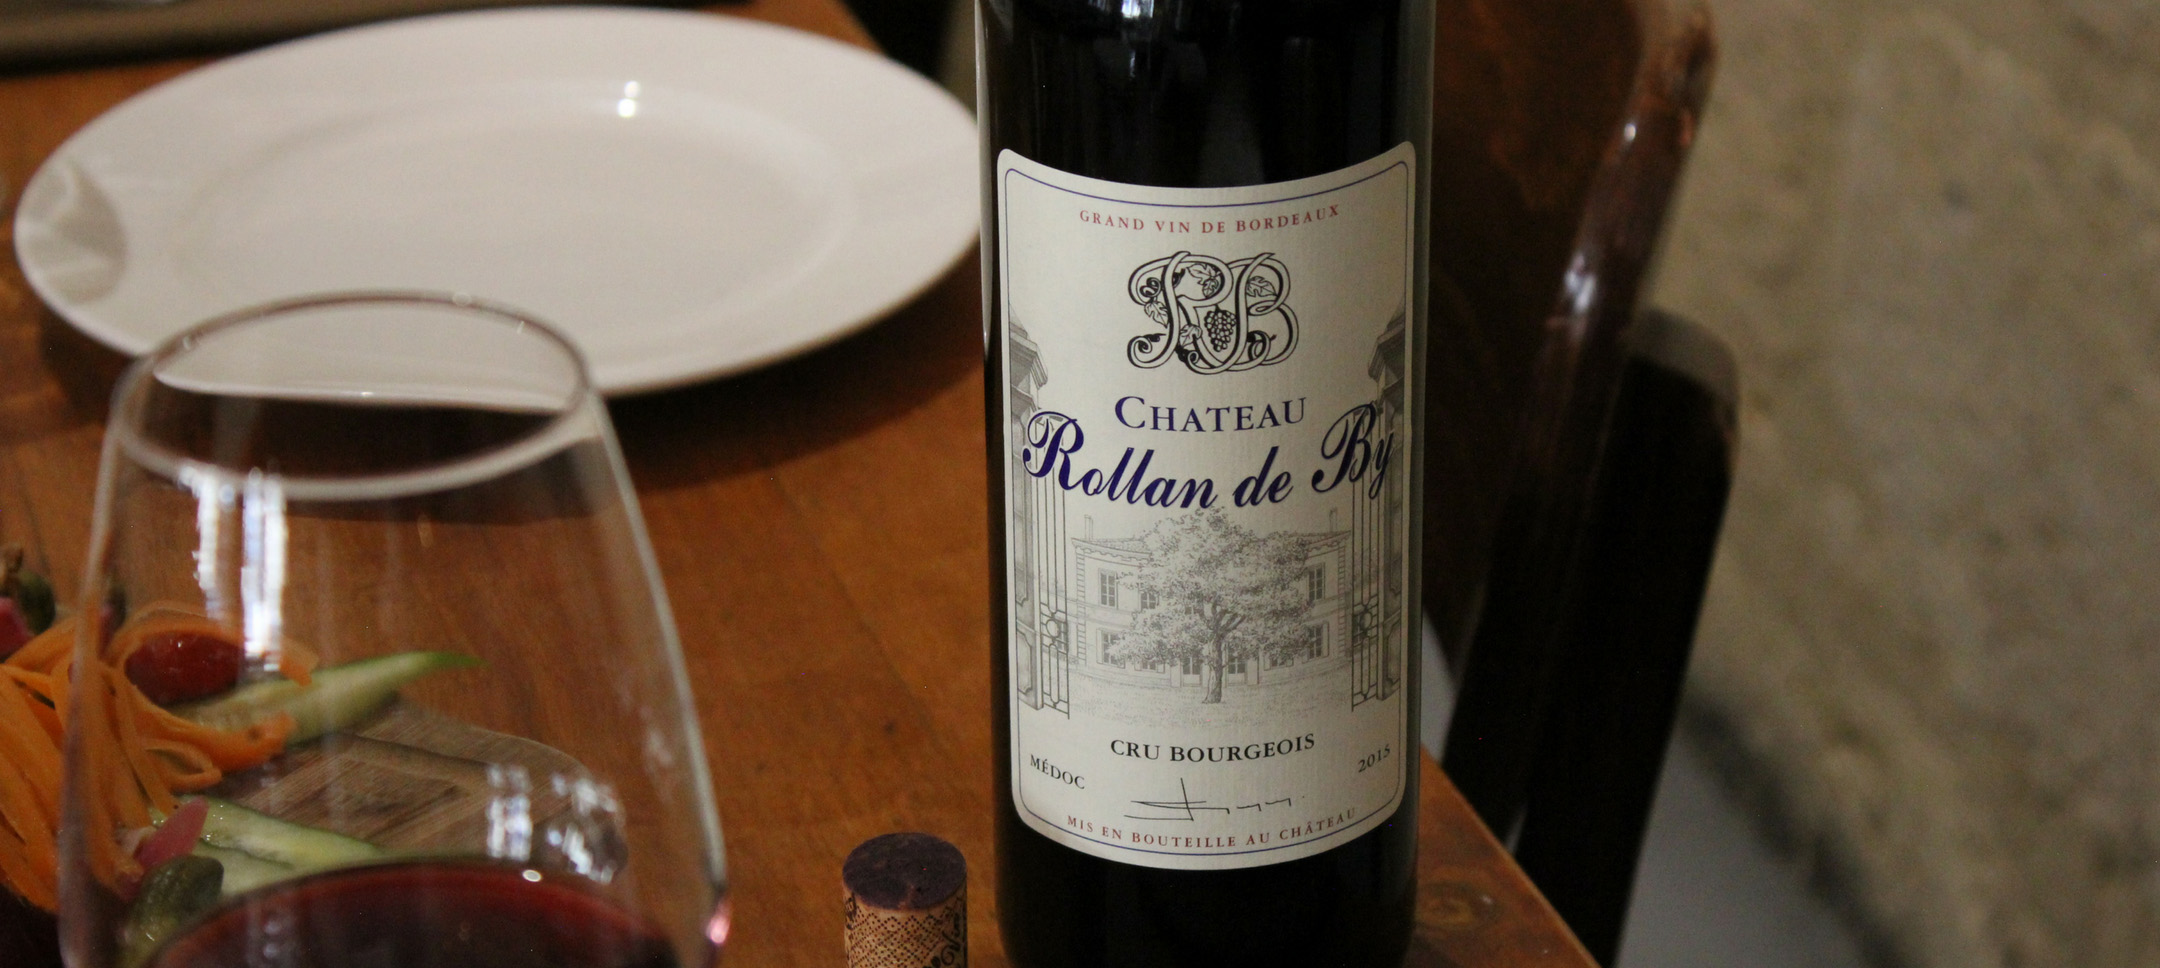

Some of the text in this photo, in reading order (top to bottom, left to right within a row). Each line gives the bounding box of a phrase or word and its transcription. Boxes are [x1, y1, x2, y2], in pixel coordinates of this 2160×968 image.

[1079, 204, 1340, 234] GRAND VIN DE BORDEAUX
[1022, 402, 1395, 509] Rollan de By
[1110, 733, 1315, 763] CRU BOURGEOIS
[1357, 744, 1391, 774] 2015
[1030, 754, 1085, 790] MÉDOC
[1067, 807, 1356, 848] MIS EN BOUTEILLE AU CHÂTEAU
